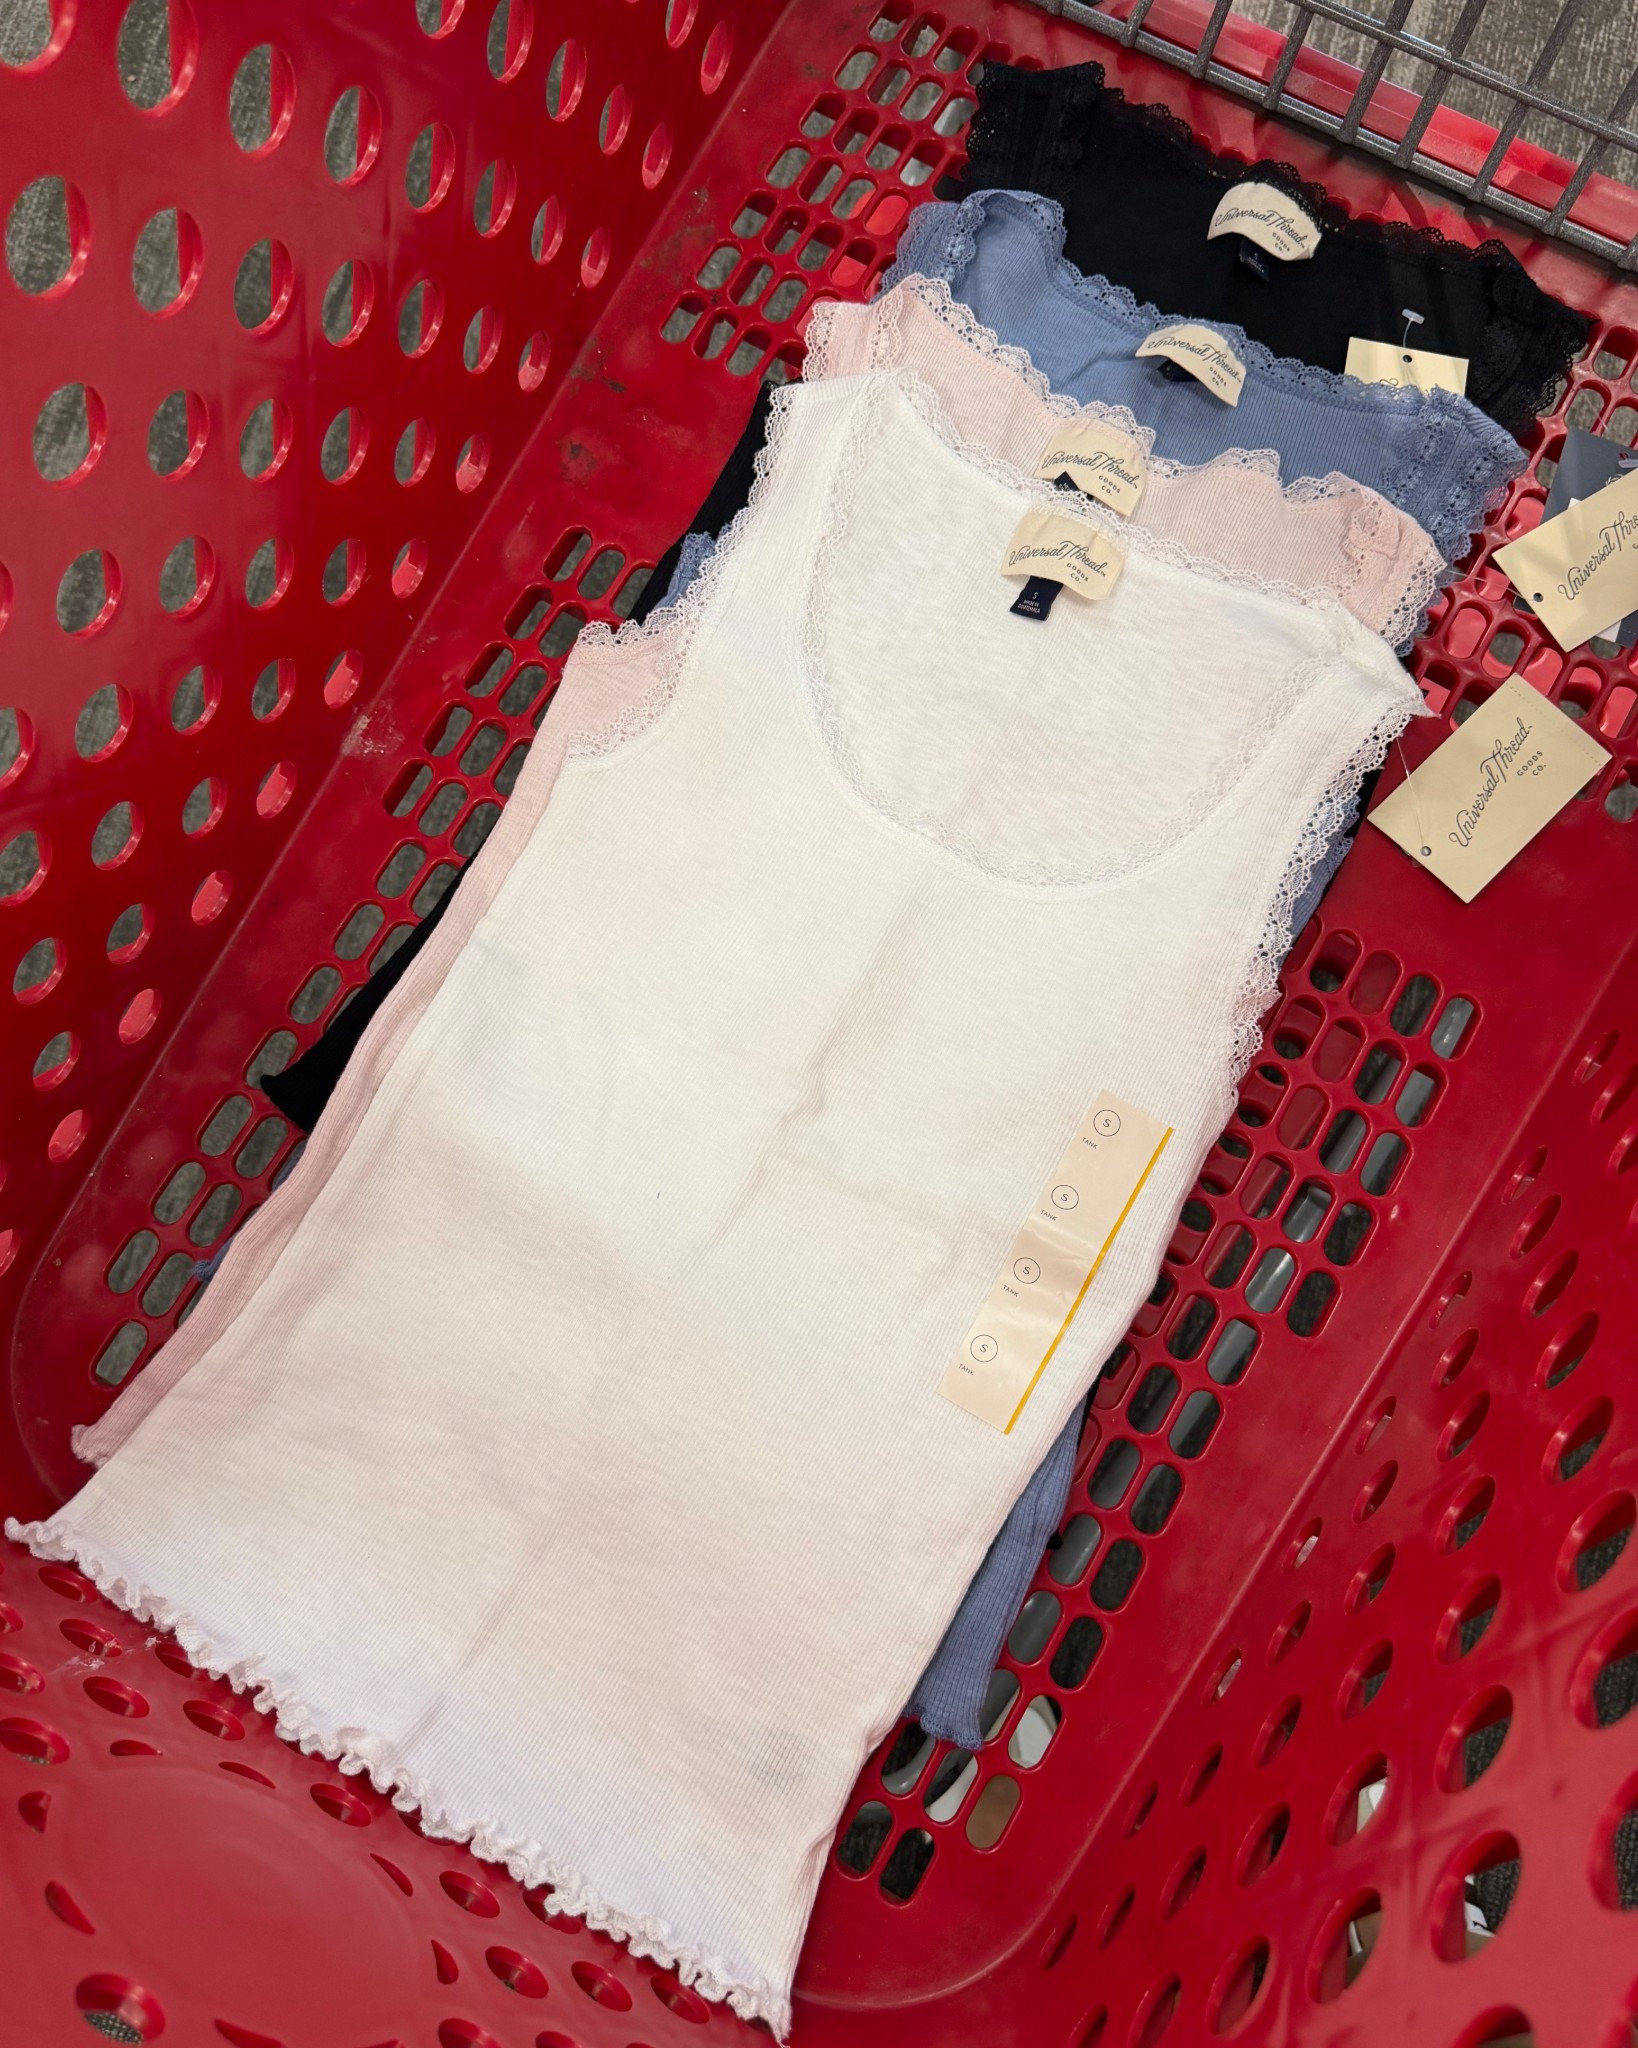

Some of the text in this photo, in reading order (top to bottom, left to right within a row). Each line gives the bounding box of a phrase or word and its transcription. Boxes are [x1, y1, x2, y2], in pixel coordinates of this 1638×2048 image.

[1214, 207, 1308, 245] Universal Thread
[1147, 336, 1207, 357] Universal
[1202, 343, 1239, 380] Thread
[1041, 450, 1140, 486] Universal Thread
[1098, 475, 1121, 494] GOODS
[1101, 485, 1113, 496] CO.
[1008, 540, 1108, 574] Universal Thread
[1558, 510, 1638, 600] Universal Thre
[1066, 562, 1089, 582] GOODS
[1070, 573, 1082, 584] CO.
[1032, 591, 1039, 600] S
[1516, 750, 1544, 777] GOODS
[1531, 764, 1548, 777] CO.
[1448, 716, 1530, 848] Universal Thread
[1102, 1118, 1112, 1128] S
[1081, 1136, 1099, 1150] TANK
[1060, 1193, 1070, 1202] S
[1040, 1209, 1058, 1222] TANK
[1022, 1266, 1031, 1275] S
[1002, 1284, 1019, 1298] TANK
[979, 1344, 989, 1353] S
[958, 1363, 975, 1377] TANK
